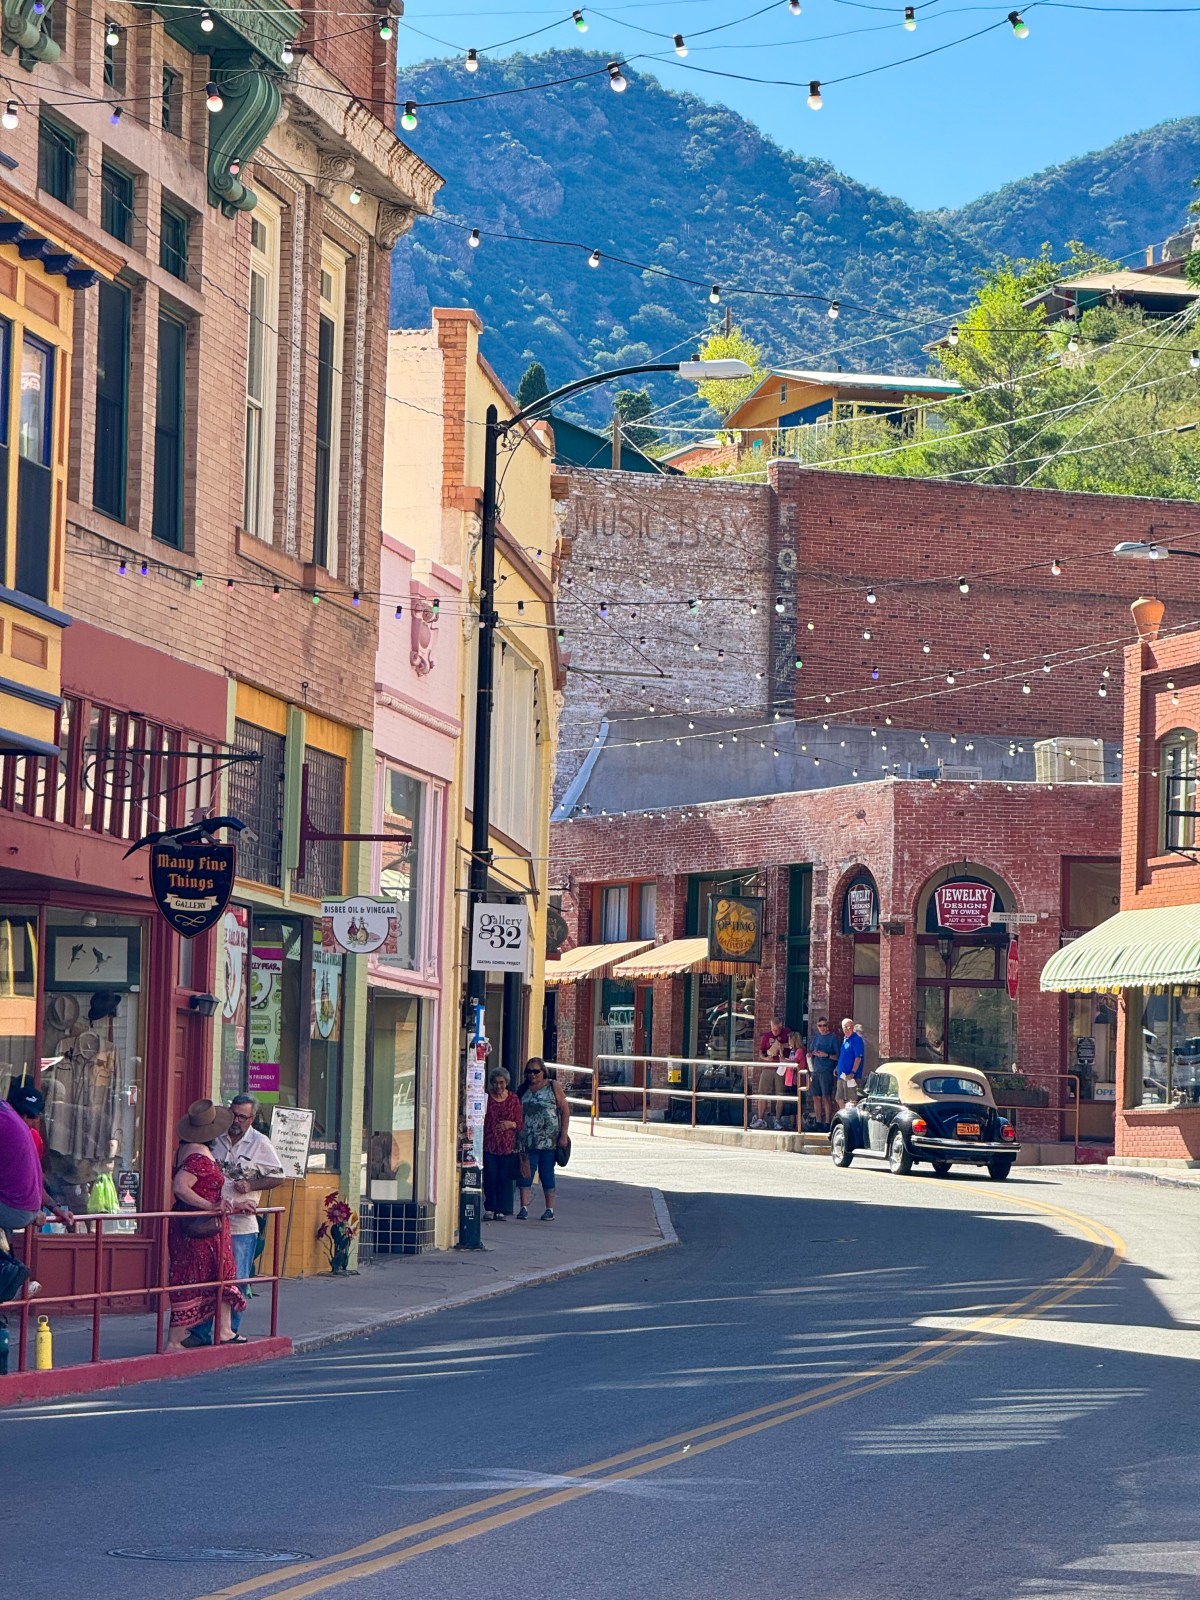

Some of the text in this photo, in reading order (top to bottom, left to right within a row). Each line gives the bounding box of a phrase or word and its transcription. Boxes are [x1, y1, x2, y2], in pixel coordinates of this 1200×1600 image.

[571, 498, 658, 541] MUSIC
[158, 854, 227, 872] Many Fine
[168, 873, 214, 891] Things
[175, 900, 206, 909] GALLERY
[942, 888, 989, 904] JEWELRY
[366, 906, 395, 914] VINEGAR
[479, 913, 523, 939] gallery
[717, 919, 755, 932] OPTIMO
[490, 925, 521, 949] 32
